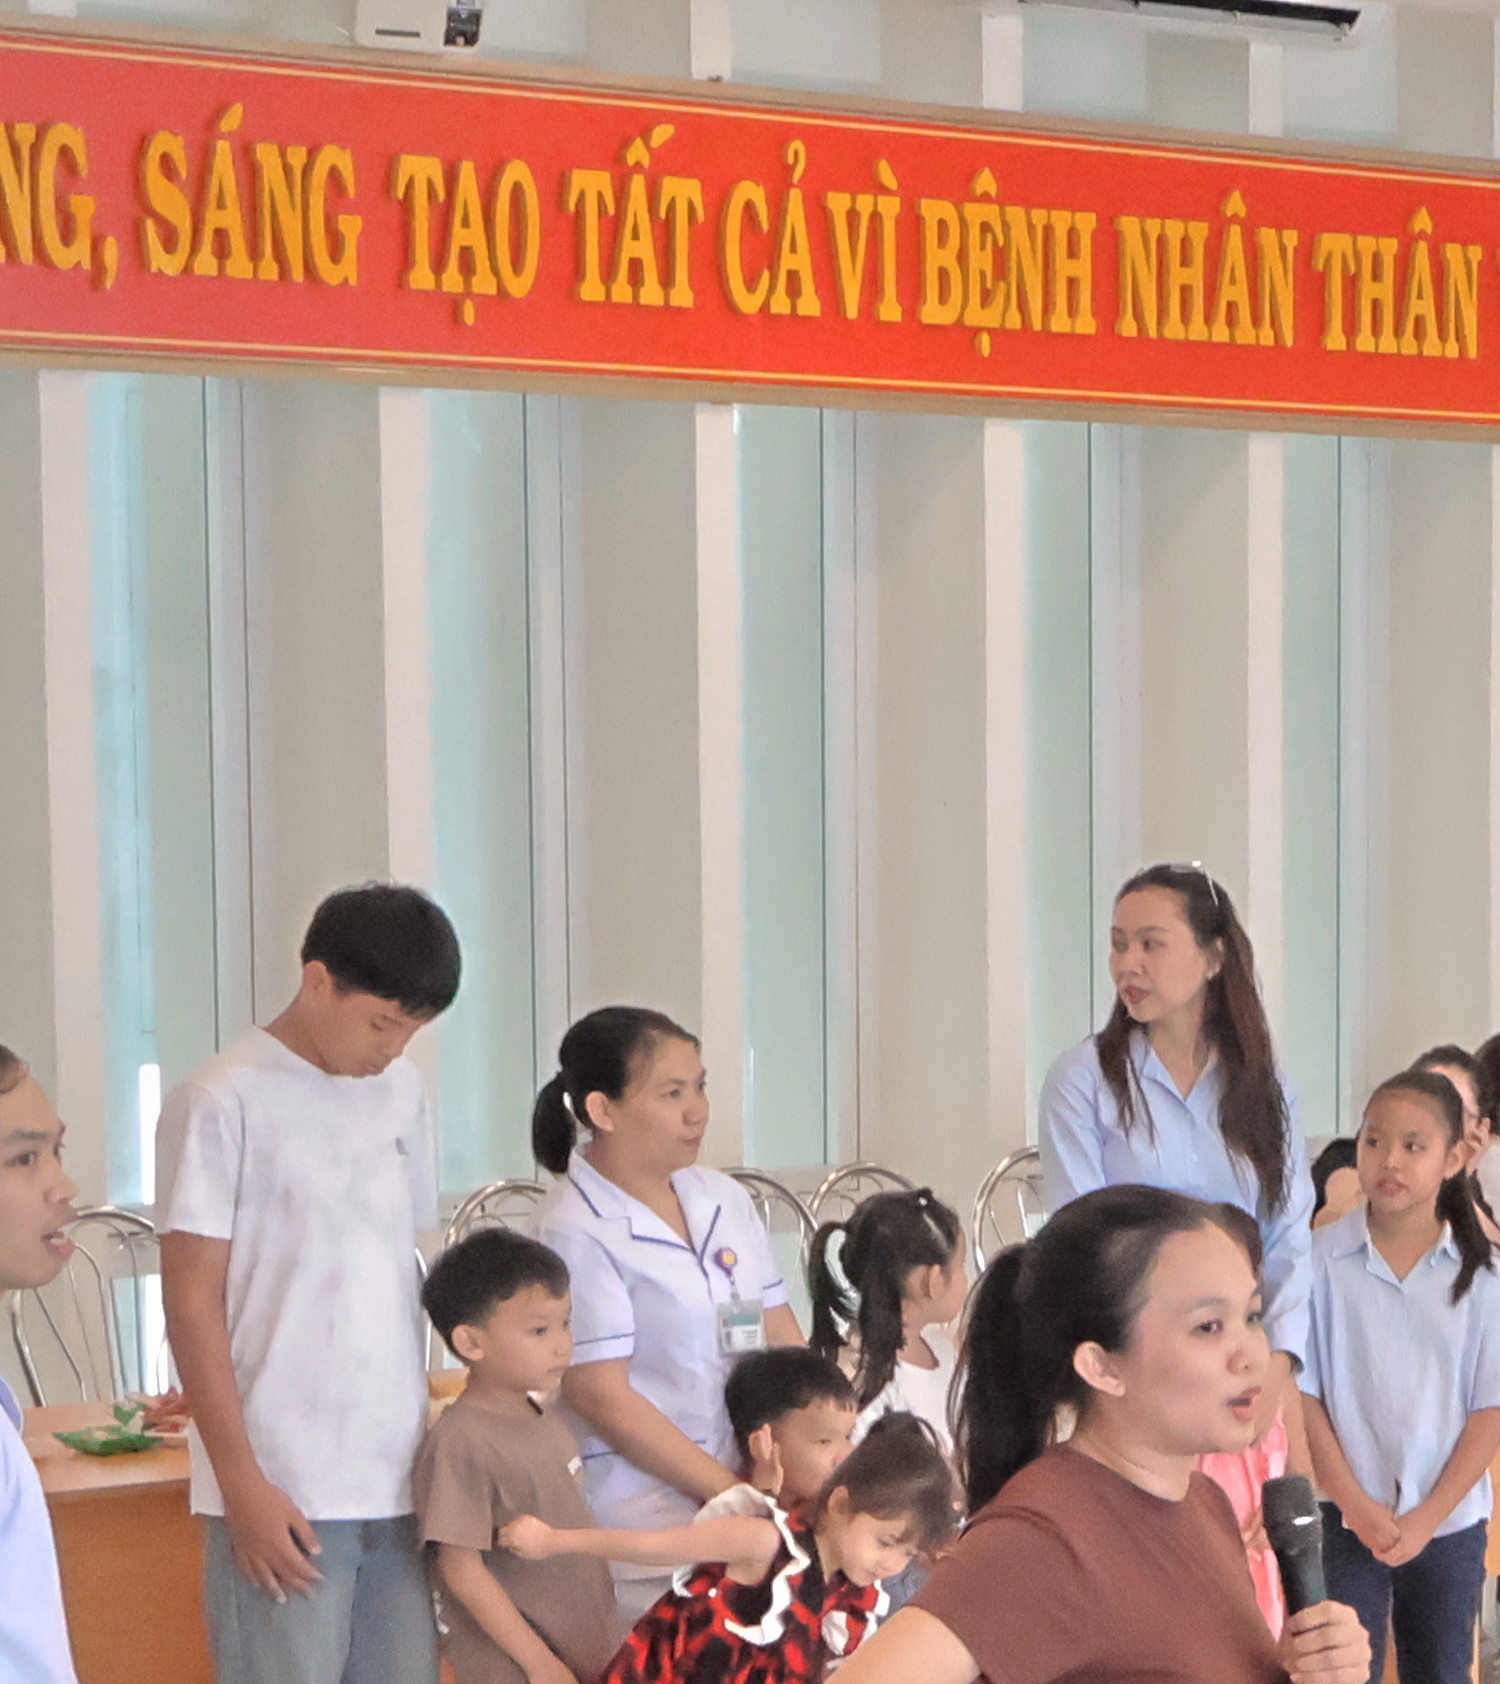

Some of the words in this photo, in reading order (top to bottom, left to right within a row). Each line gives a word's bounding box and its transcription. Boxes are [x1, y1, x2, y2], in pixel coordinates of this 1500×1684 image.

[144, 103, 362, 286] SÁNG
[394, 154, 541, 325] TẠO
[566, 124, 705, 308] TẤT
[722, 139, 821, 317] CẢ
[825, 159, 903, 323] VÌ
[918, 168, 1097, 357] BỆNH
[1115, 190, 1299, 348] NHÂN
[1312, 206, 1484, 359] THÂN
